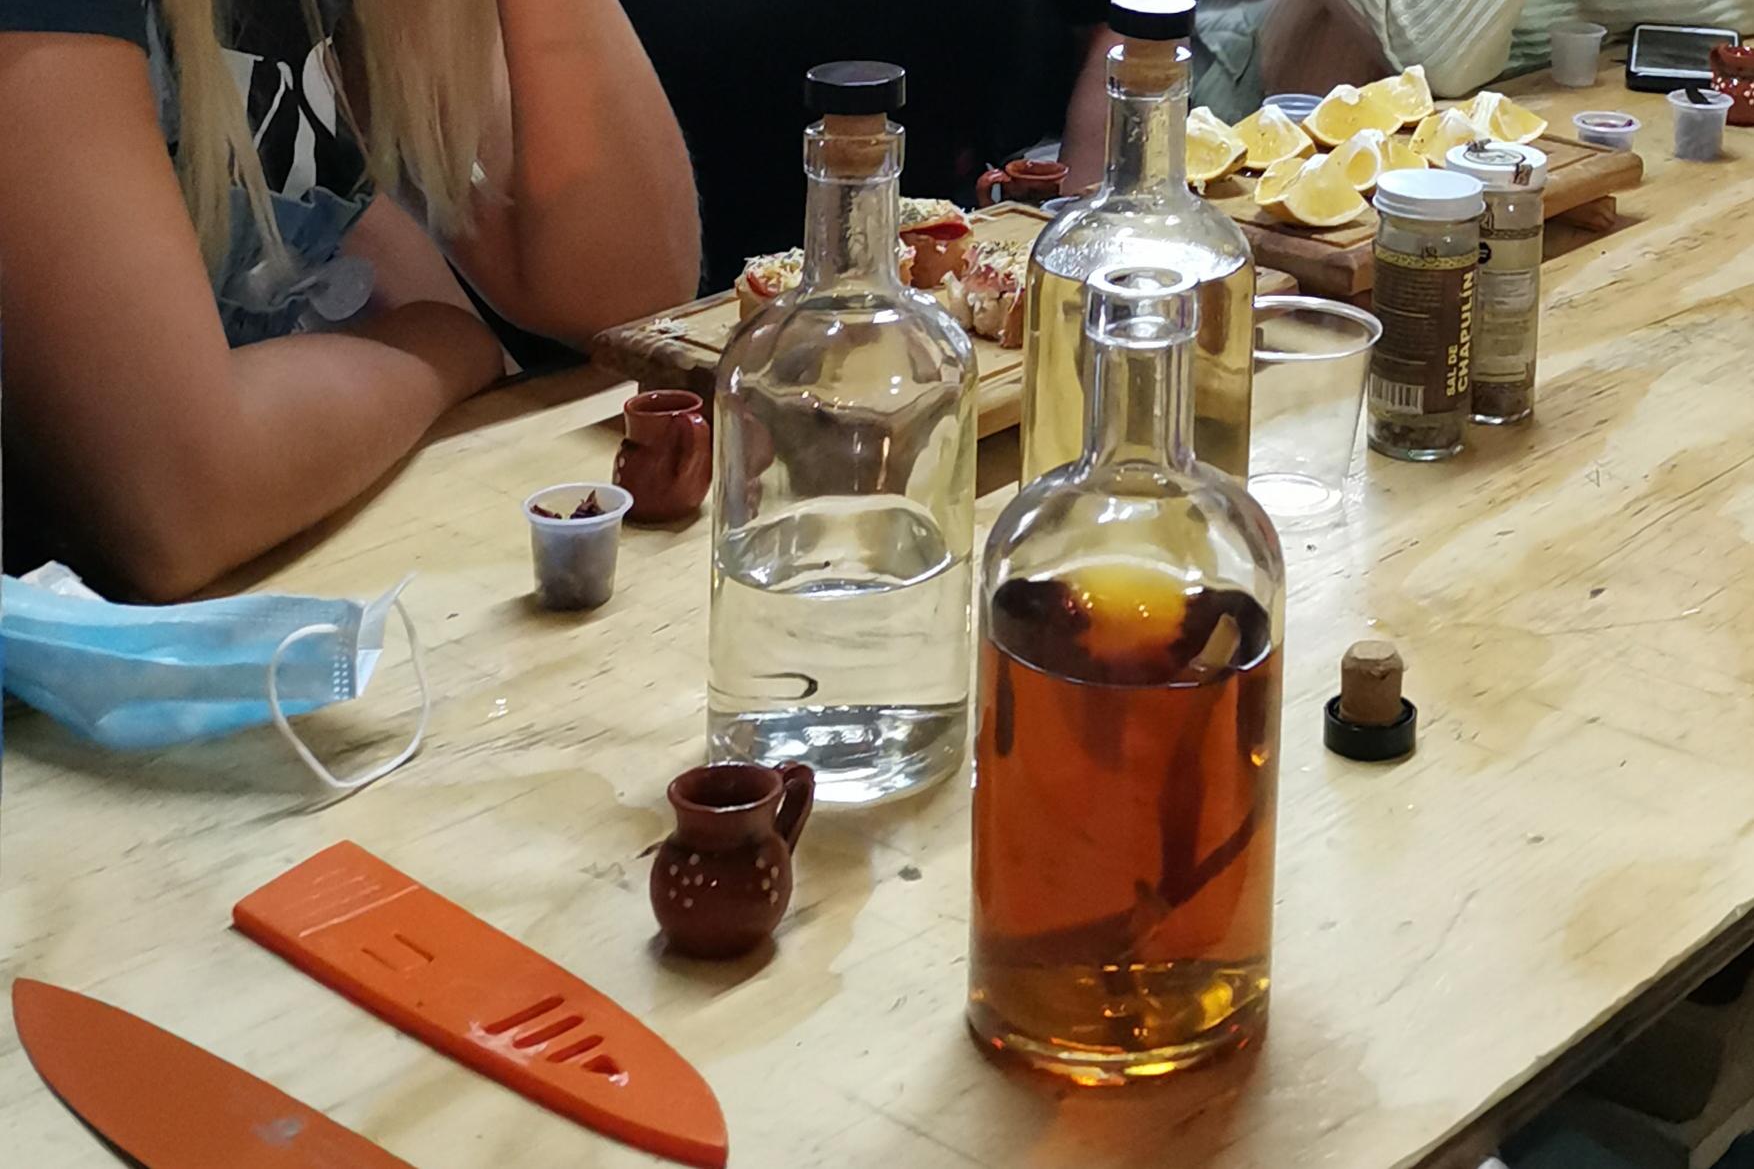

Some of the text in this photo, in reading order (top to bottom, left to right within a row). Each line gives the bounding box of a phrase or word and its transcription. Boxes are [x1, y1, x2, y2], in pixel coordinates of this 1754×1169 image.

[1446, 344, 1458, 397] SAL DE
[1458, 271, 1475, 392] CHAPULÍN
